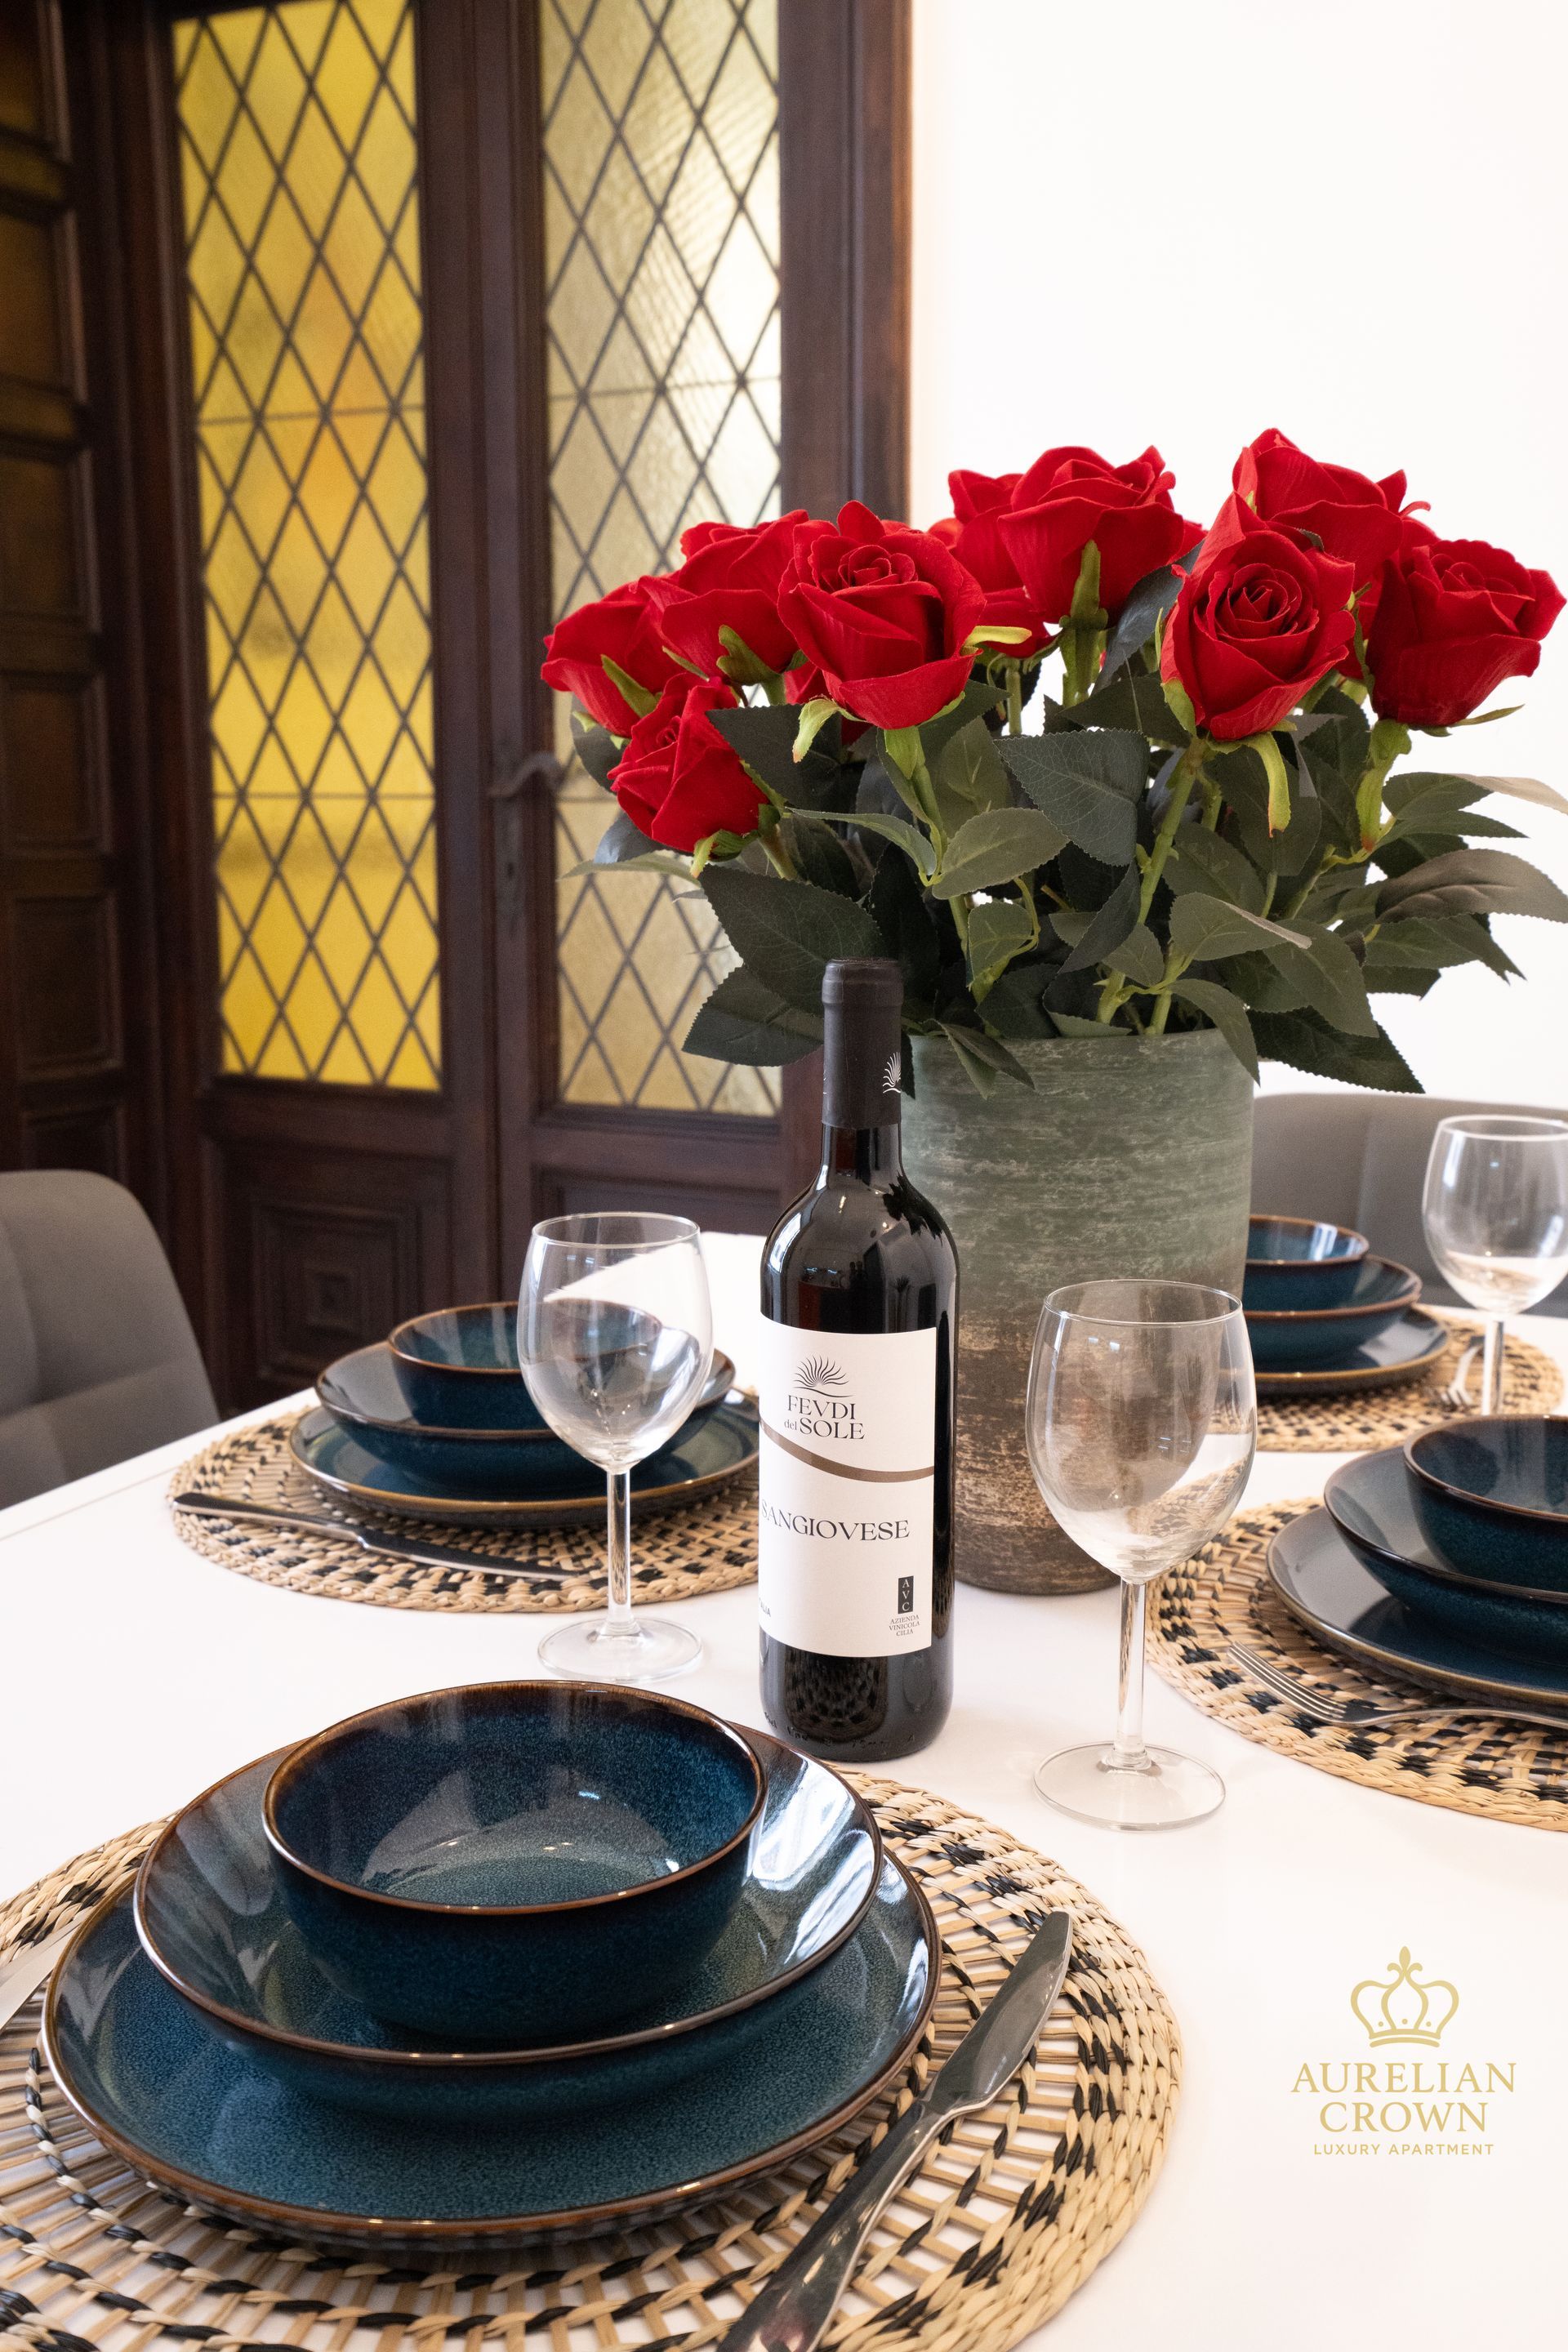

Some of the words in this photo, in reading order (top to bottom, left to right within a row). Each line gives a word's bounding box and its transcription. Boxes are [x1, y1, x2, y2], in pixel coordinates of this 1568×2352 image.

[784, 1419, 798, 1431] del
[800, 1417, 866, 1440] SOLE
[761, 1499, 911, 1542] SANGIOVESE
[889, 1615, 920, 1624] AZIENDA
[889, 1621, 920, 1631] VINICOLA
